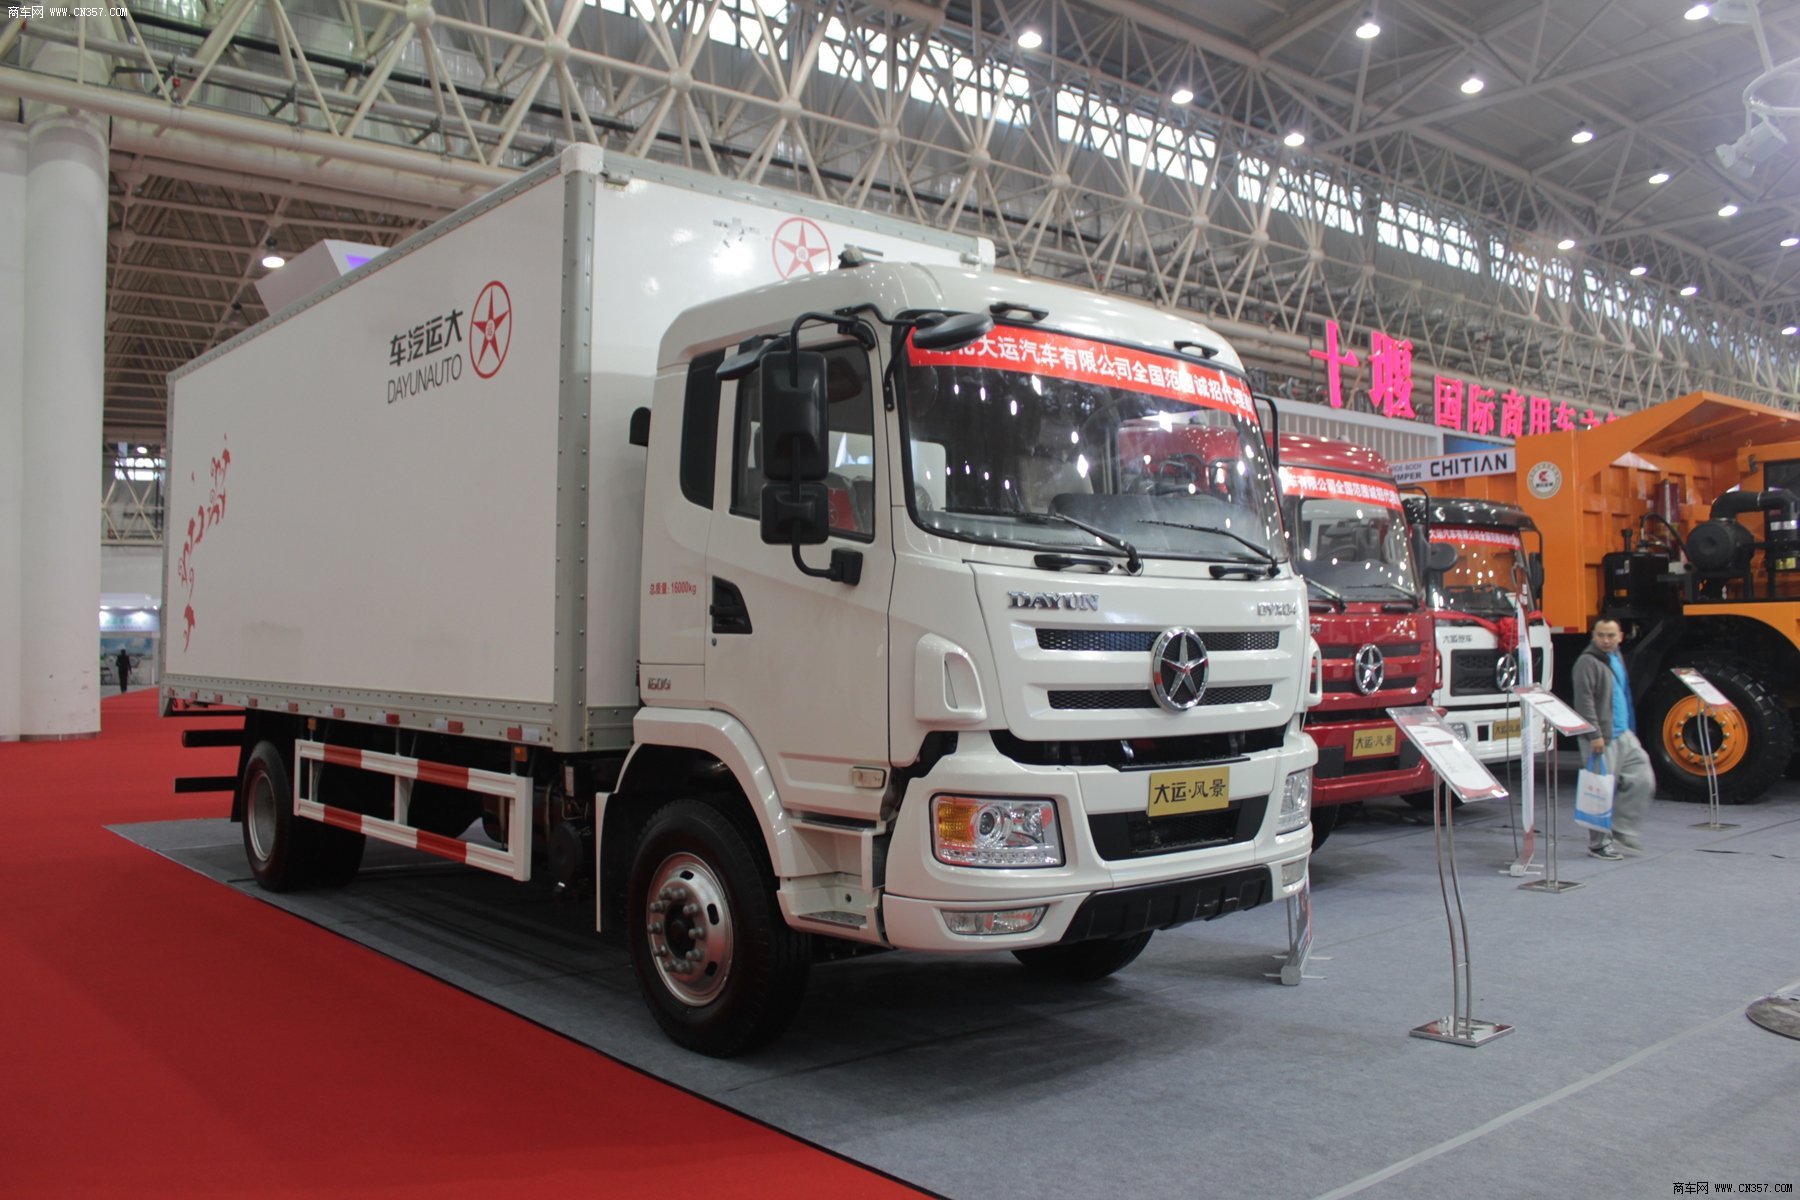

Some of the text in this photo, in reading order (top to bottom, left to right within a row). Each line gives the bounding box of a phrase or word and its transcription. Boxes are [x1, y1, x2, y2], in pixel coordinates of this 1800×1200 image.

[388, 354, 462, 404] DAYUNAUTO
[1309, 320, 1619, 438] 十堰 国际商用车
[1430, 453, 1507, 477] CHITIAN
[1008, 591, 1099, 611] DAYUN
